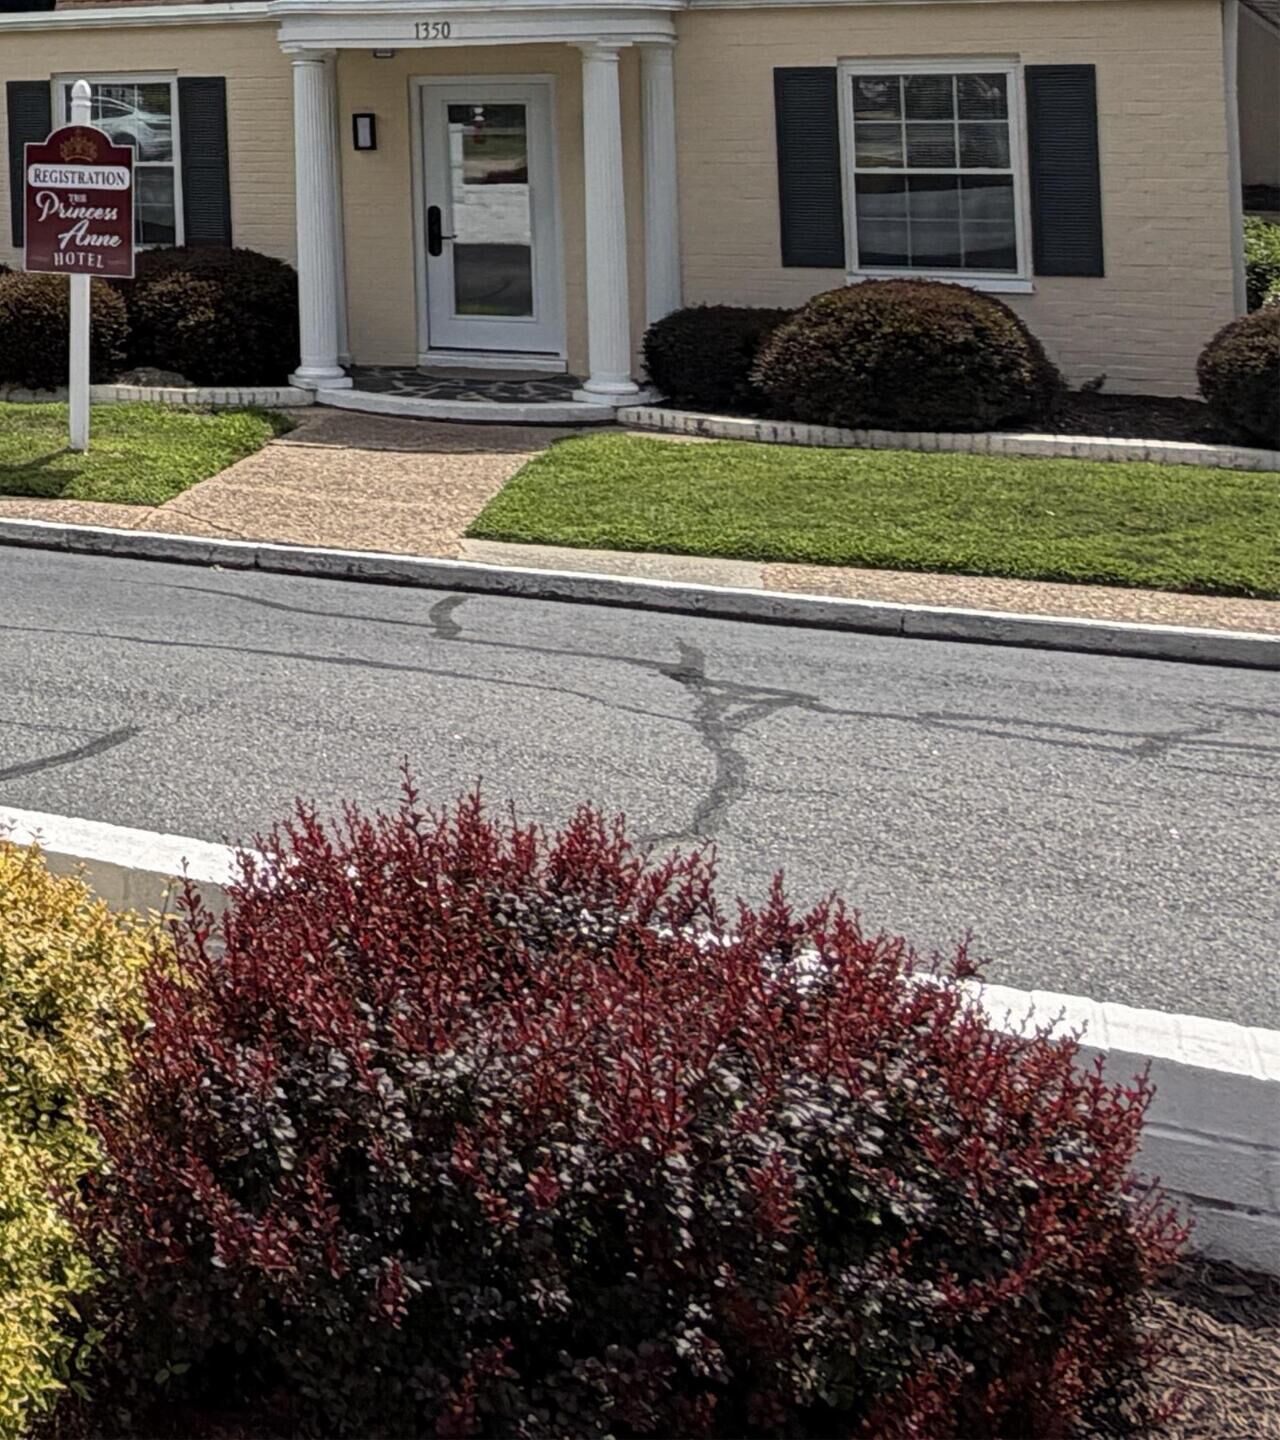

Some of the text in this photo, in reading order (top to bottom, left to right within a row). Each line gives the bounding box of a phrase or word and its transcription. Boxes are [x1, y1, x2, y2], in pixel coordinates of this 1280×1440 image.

[414, 21, 451, 40] 1350
[33, 167, 126, 186] REGISTRATION
[35, 190, 118, 222] Princess
[68, 193, 87, 203] THE
[57, 219, 122, 250] Anne
[53, 251, 104, 269] HOTEL
